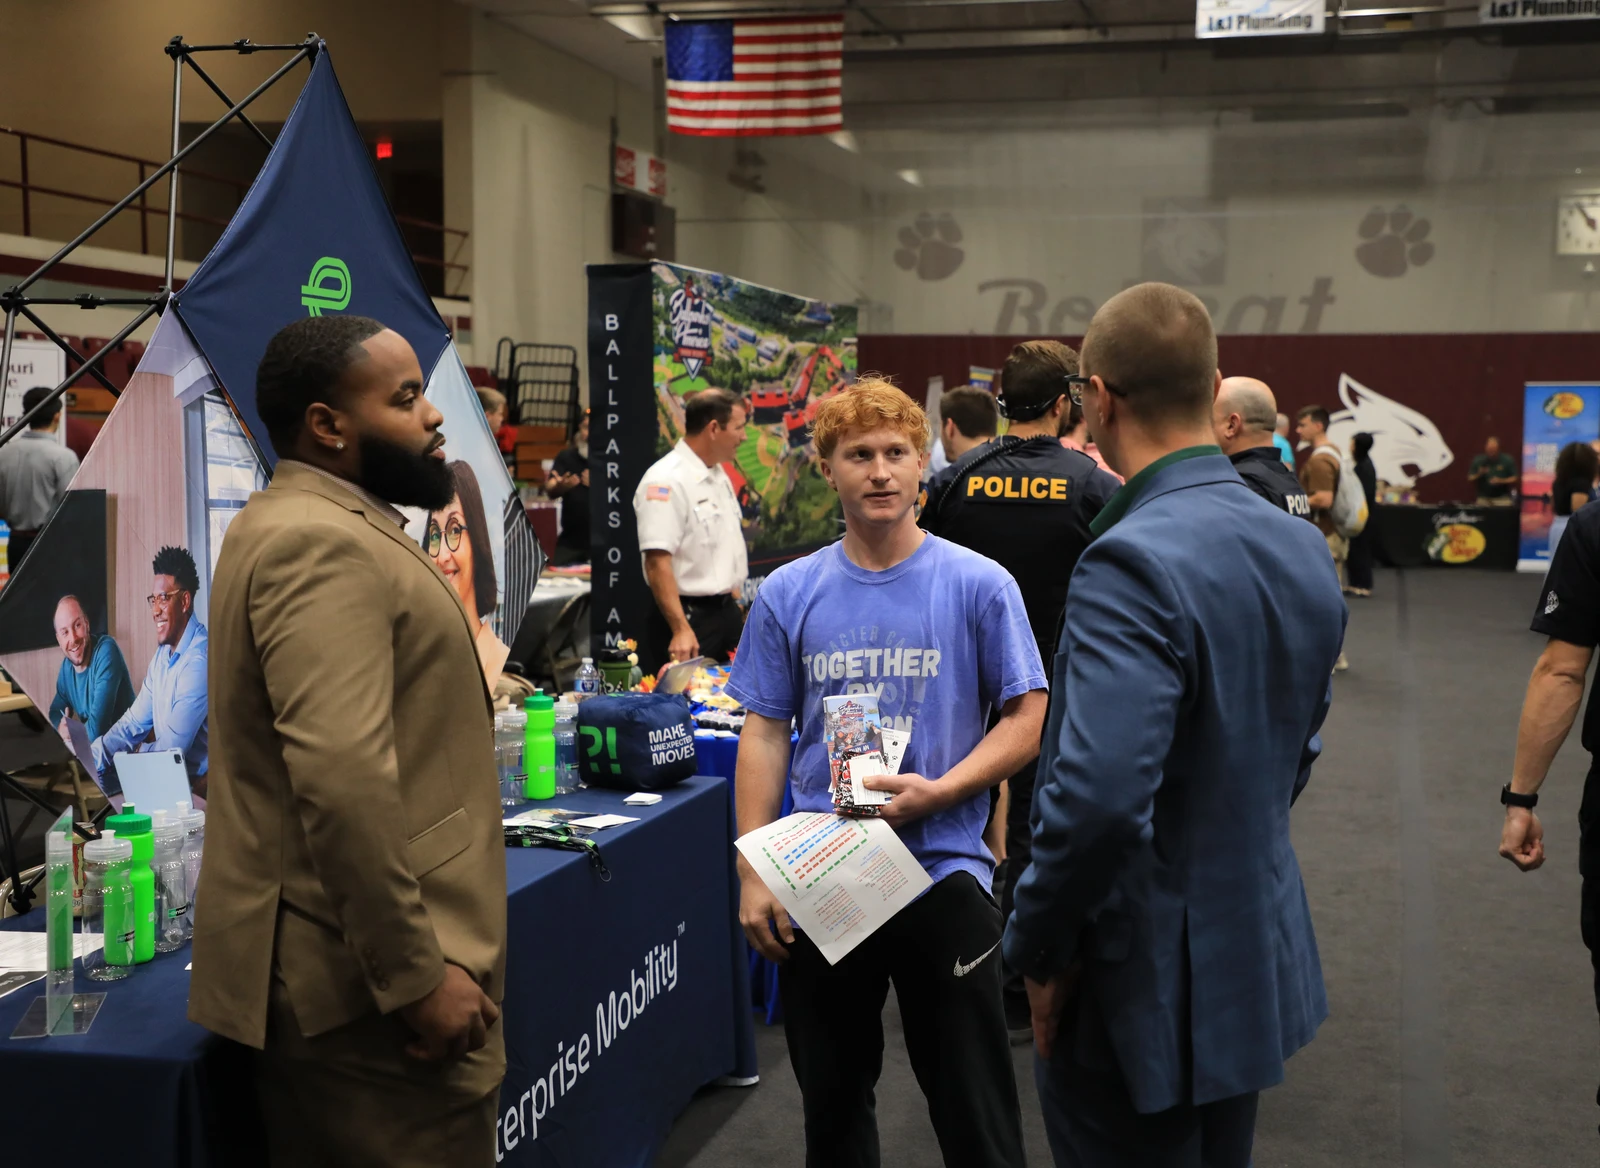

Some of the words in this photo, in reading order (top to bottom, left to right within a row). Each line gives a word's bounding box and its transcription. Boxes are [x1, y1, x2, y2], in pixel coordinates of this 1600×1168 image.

[977, 278, 1337, 336] Beat
[605, 313, 622, 528] BALLPARKS
[966, 476, 1068, 500] POLICE
[607, 547, 621, 588] OF
[822, 625, 880, 654] ACTER
[802, 648, 942, 682] TOGETHER
[648, 723, 687, 744] MAKE
[650, 735, 693, 752] UNEXPECTED
[652, 743, 695, 766] MOVES
[596, 939, 678, 1057] Mobility
